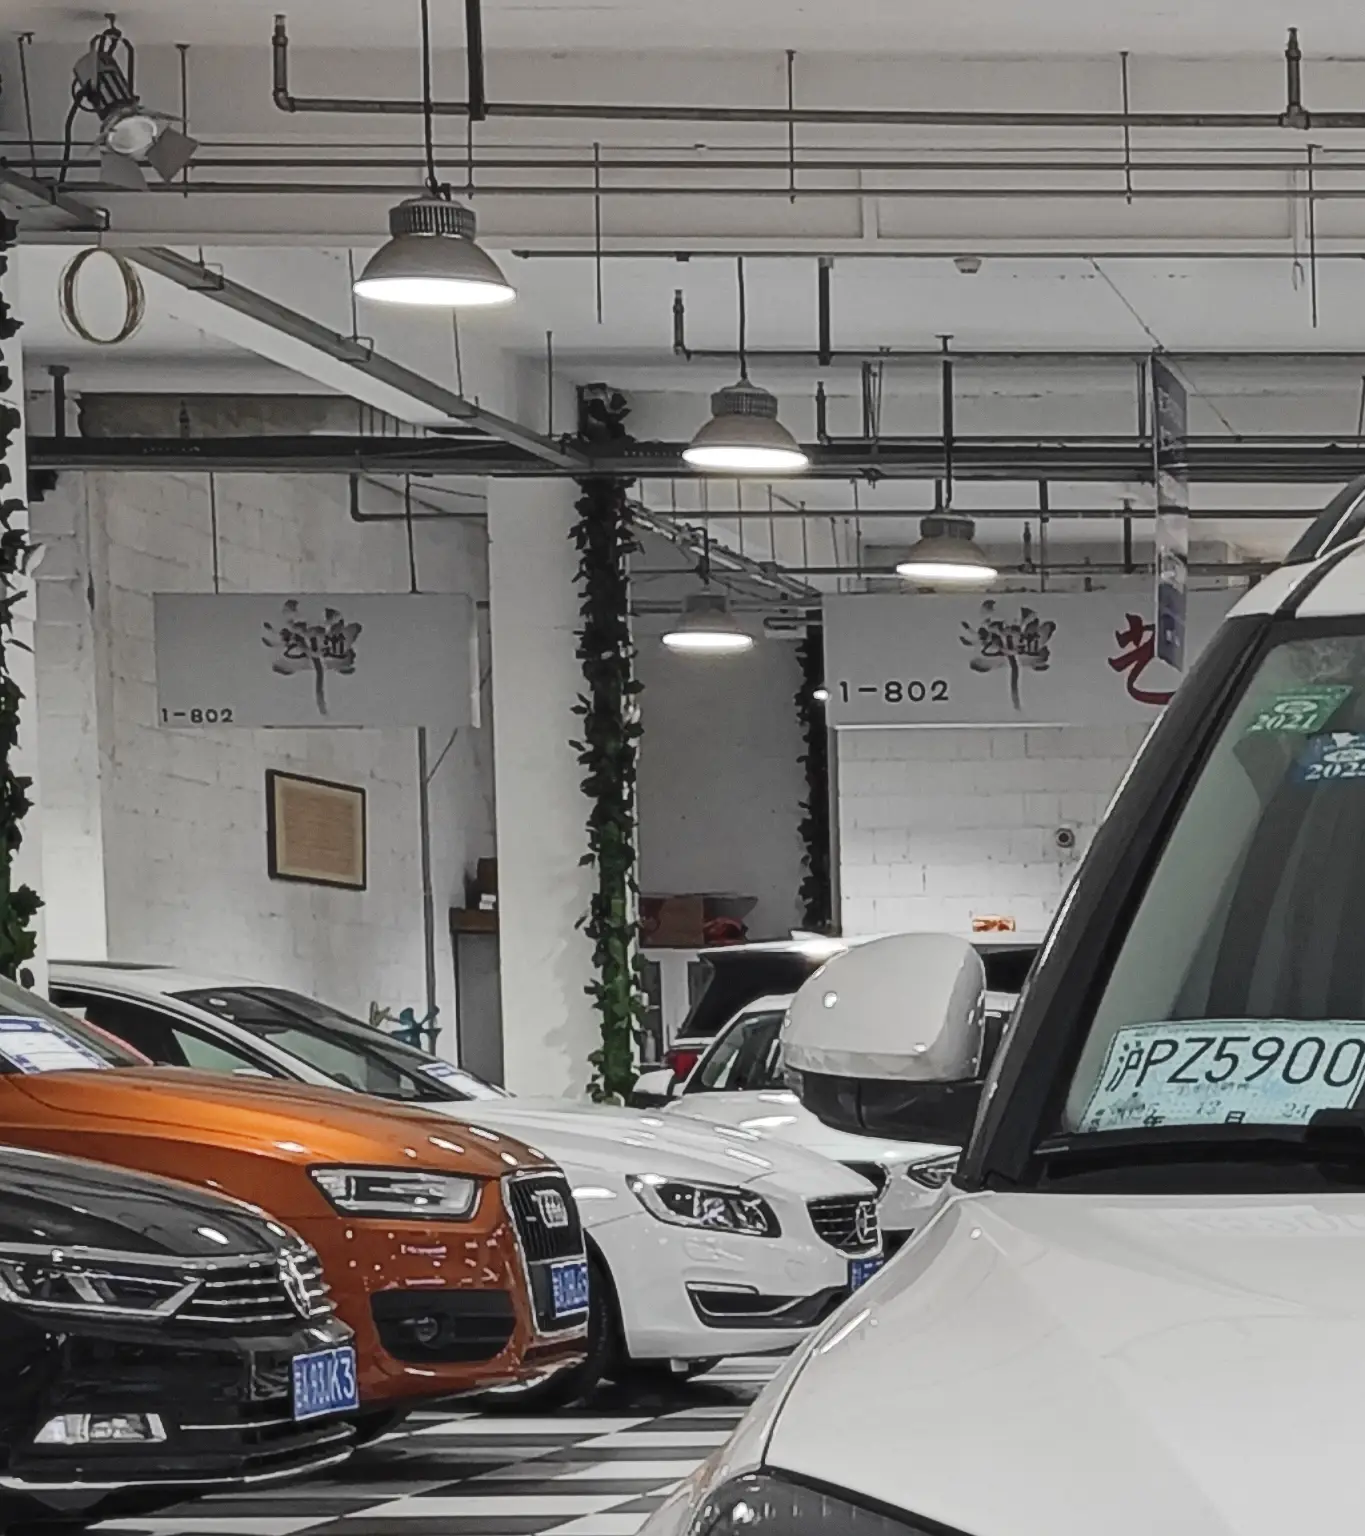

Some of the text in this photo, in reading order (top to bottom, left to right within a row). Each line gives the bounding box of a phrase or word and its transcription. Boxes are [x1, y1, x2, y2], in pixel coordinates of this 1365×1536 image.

[839, 680, 949, 703] 1-802
[161, 708, 233, 724] 1-802
[1247, 713, 1318, 731] 2021
[1105, 1036, 1365, 1092] 沪PZ5900
